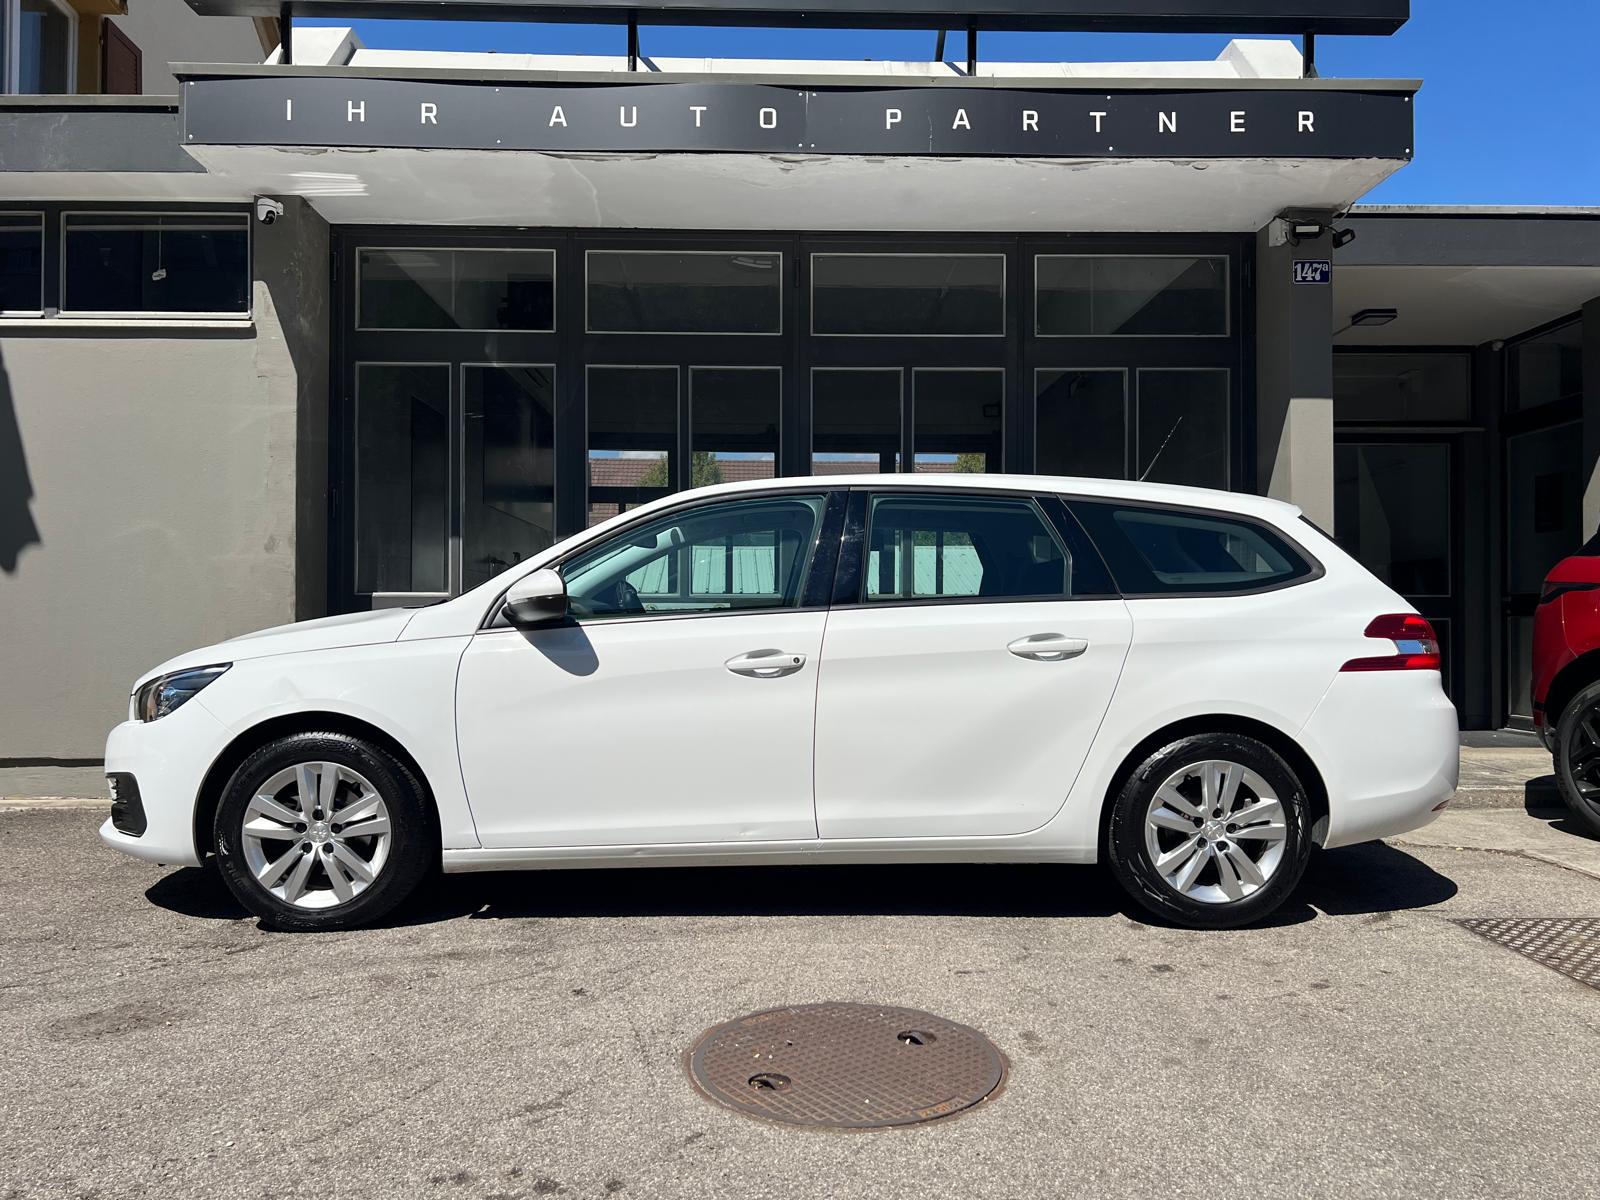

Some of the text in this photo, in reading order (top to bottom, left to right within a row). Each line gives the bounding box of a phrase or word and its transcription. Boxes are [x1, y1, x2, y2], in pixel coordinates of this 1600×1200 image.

[286, 98, 1315, 133] IHR AUTO PARTNER
[1294, 262, 1329, 281] 147a
